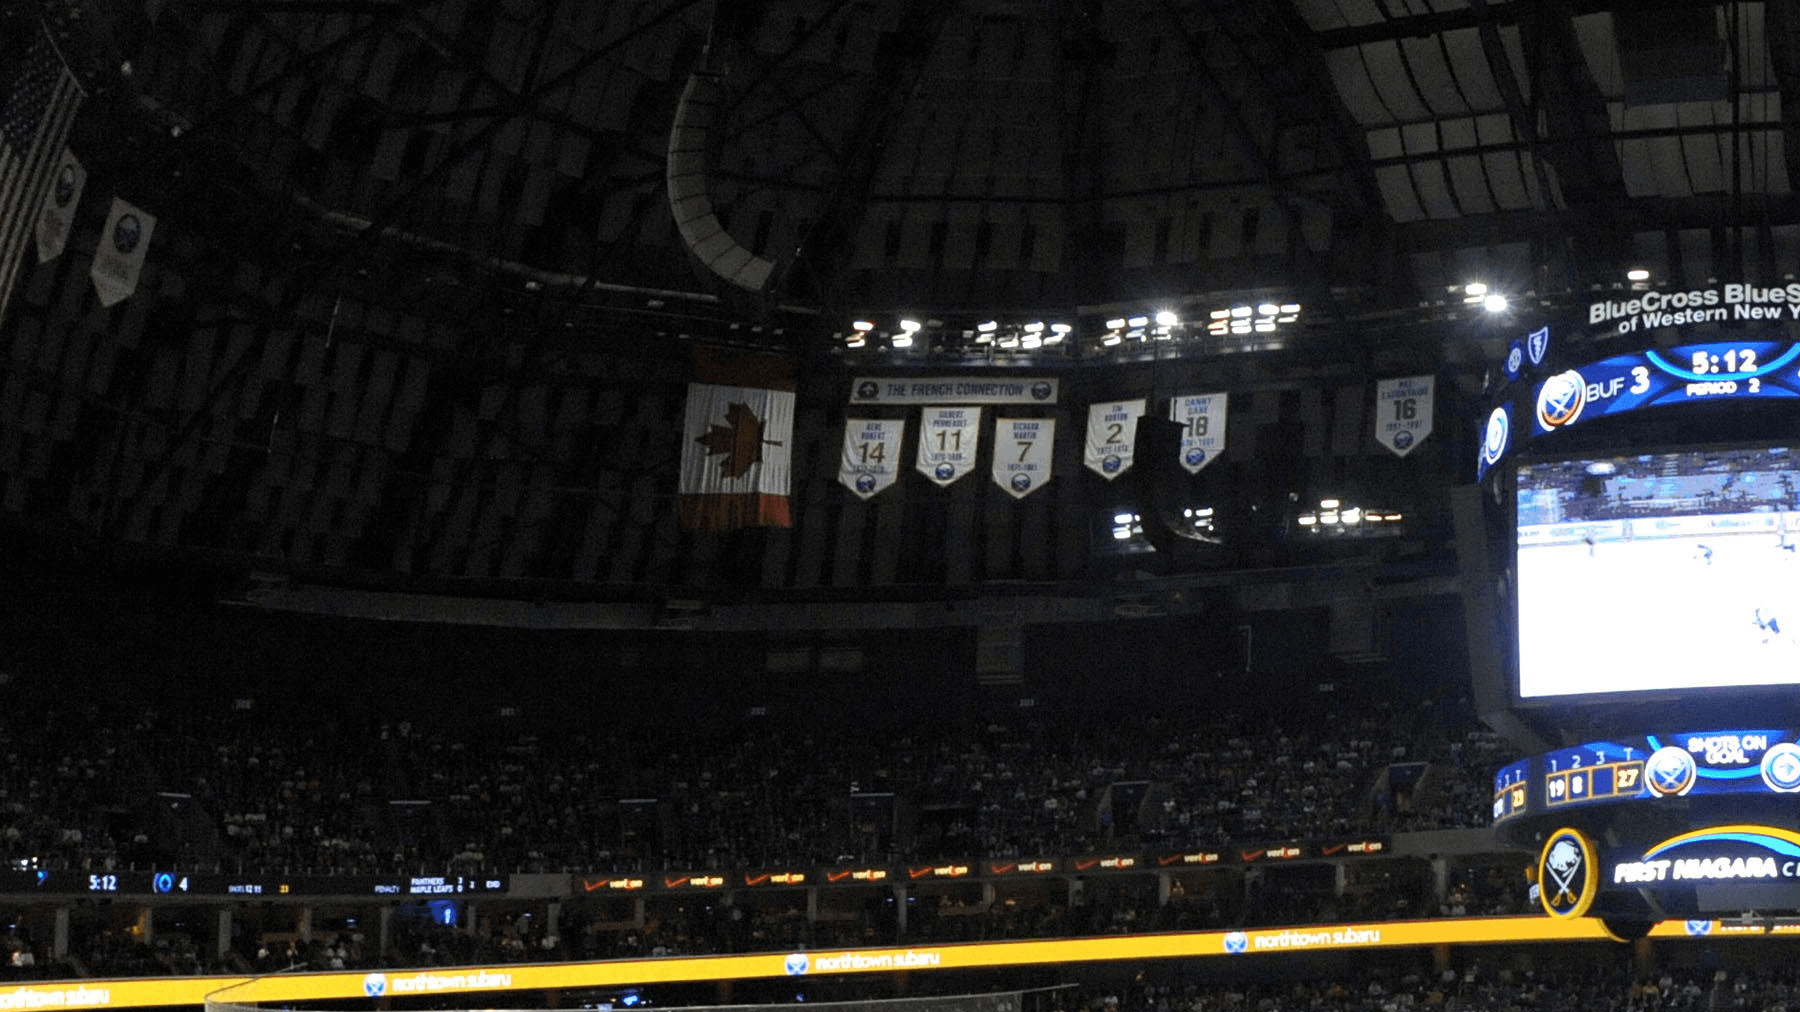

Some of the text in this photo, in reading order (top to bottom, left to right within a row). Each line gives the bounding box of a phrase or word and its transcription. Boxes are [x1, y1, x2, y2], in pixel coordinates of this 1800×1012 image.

[1589, 289, 1719, 324] BlueCross
[1618, 316, 1637, 334] of
[1643, 306, 1728, 328] Western
[1734, 304, 1782, 320] New
[1692, 349, 1758, 374] 5:12
[887, 382, 1024, 397] THE FRENCH CONNECTION
[1586, 366, 1650, 401] BUF 3
[1686, 378, 1760, 396] PERIOD 2
[1394, 398, 1416, 421] 16
[1106, 423, 1122, 444] 2
[1186, 416, 1208, 437] 18
[936, 429, 961, 452] 11
[859, 441, 885, 463] 14
[1017, 441, 1033, 462] 7
[1688, 735, 1767, 752] SHOTS ON
[1551, 747, 1634, 772] 1 2 3 T
[1706, 750, 1749, 764] GOAL
[1549, 768, 1639, 798] 19 8 27
[1614, 860, 1671, 883] FIRST
[1673, 857, 1778, 880] NIAGARA
[89, 875, 117, 891] 5:12
[179, 877, 188, 891] 4
[1254, 928, 1380, 949] northtown subaru
[816, 950, 940, 971] northtown subaru
[393, 971, 512, 992] northtown subaru
[0, 986, 64, 1009] orthtown
